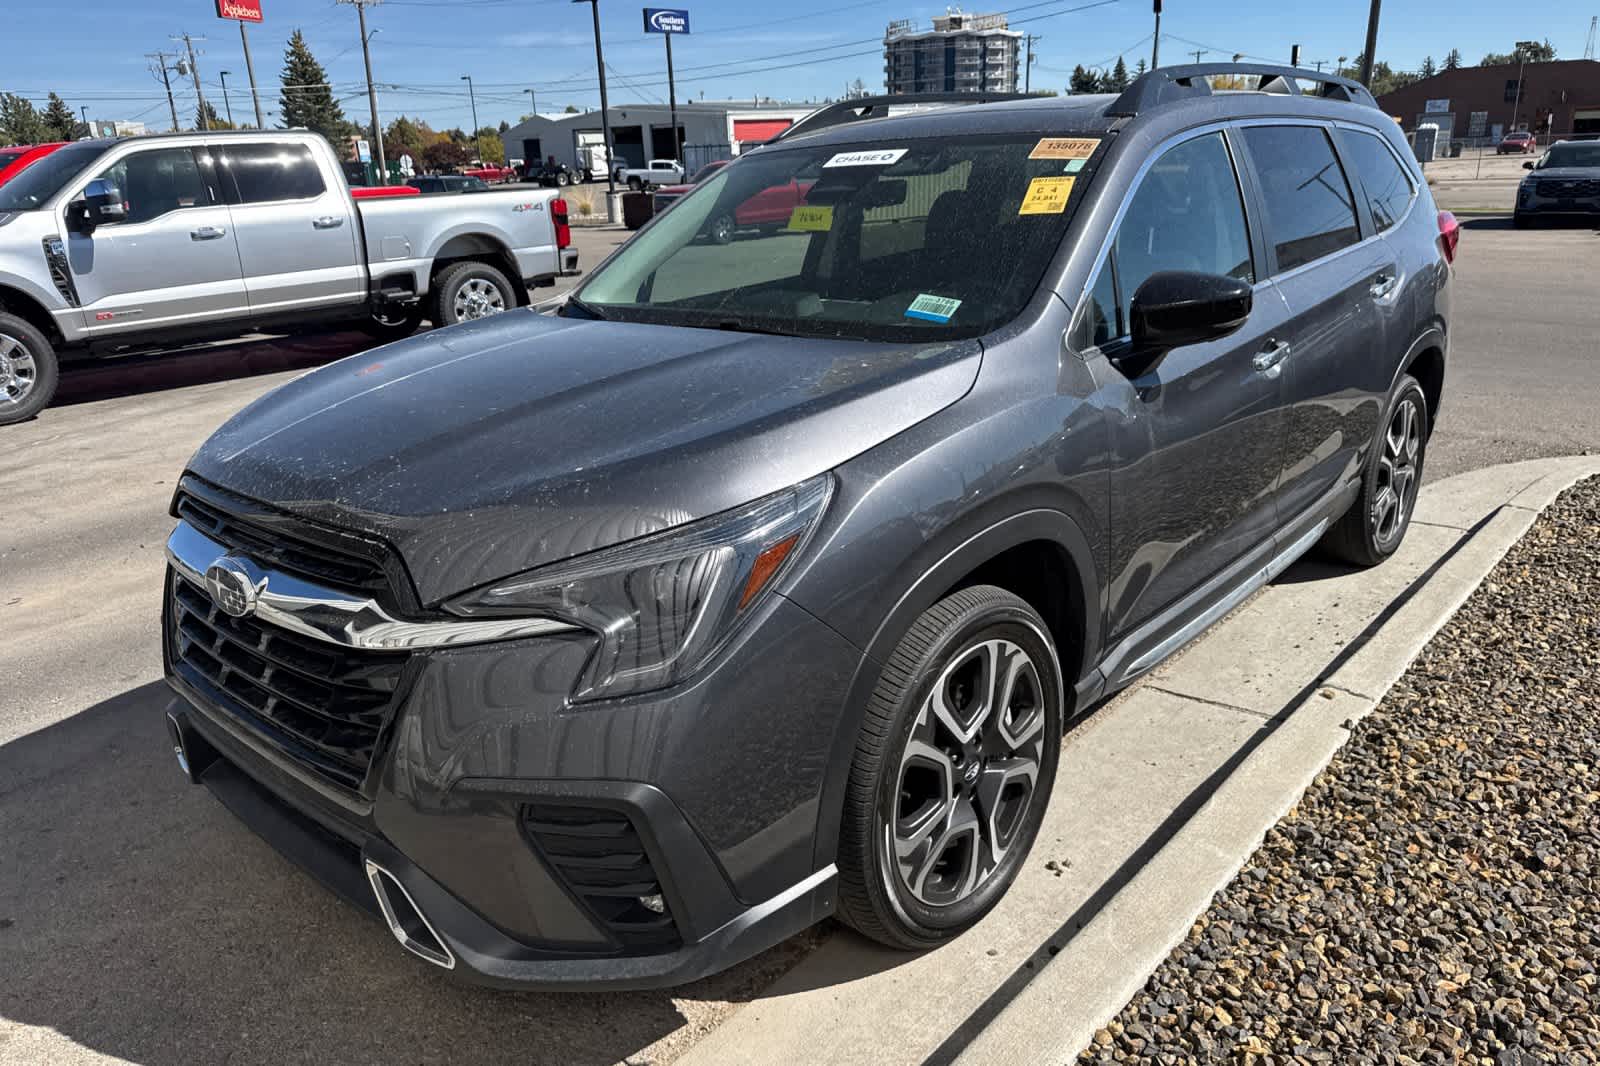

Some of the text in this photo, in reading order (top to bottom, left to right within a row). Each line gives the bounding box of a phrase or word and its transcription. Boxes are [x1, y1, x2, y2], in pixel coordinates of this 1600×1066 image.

[658, 15, 685, 25] Southern
[1047, 142, 1092, 150] 135078
[835, 154, 880, 163] CHASE
